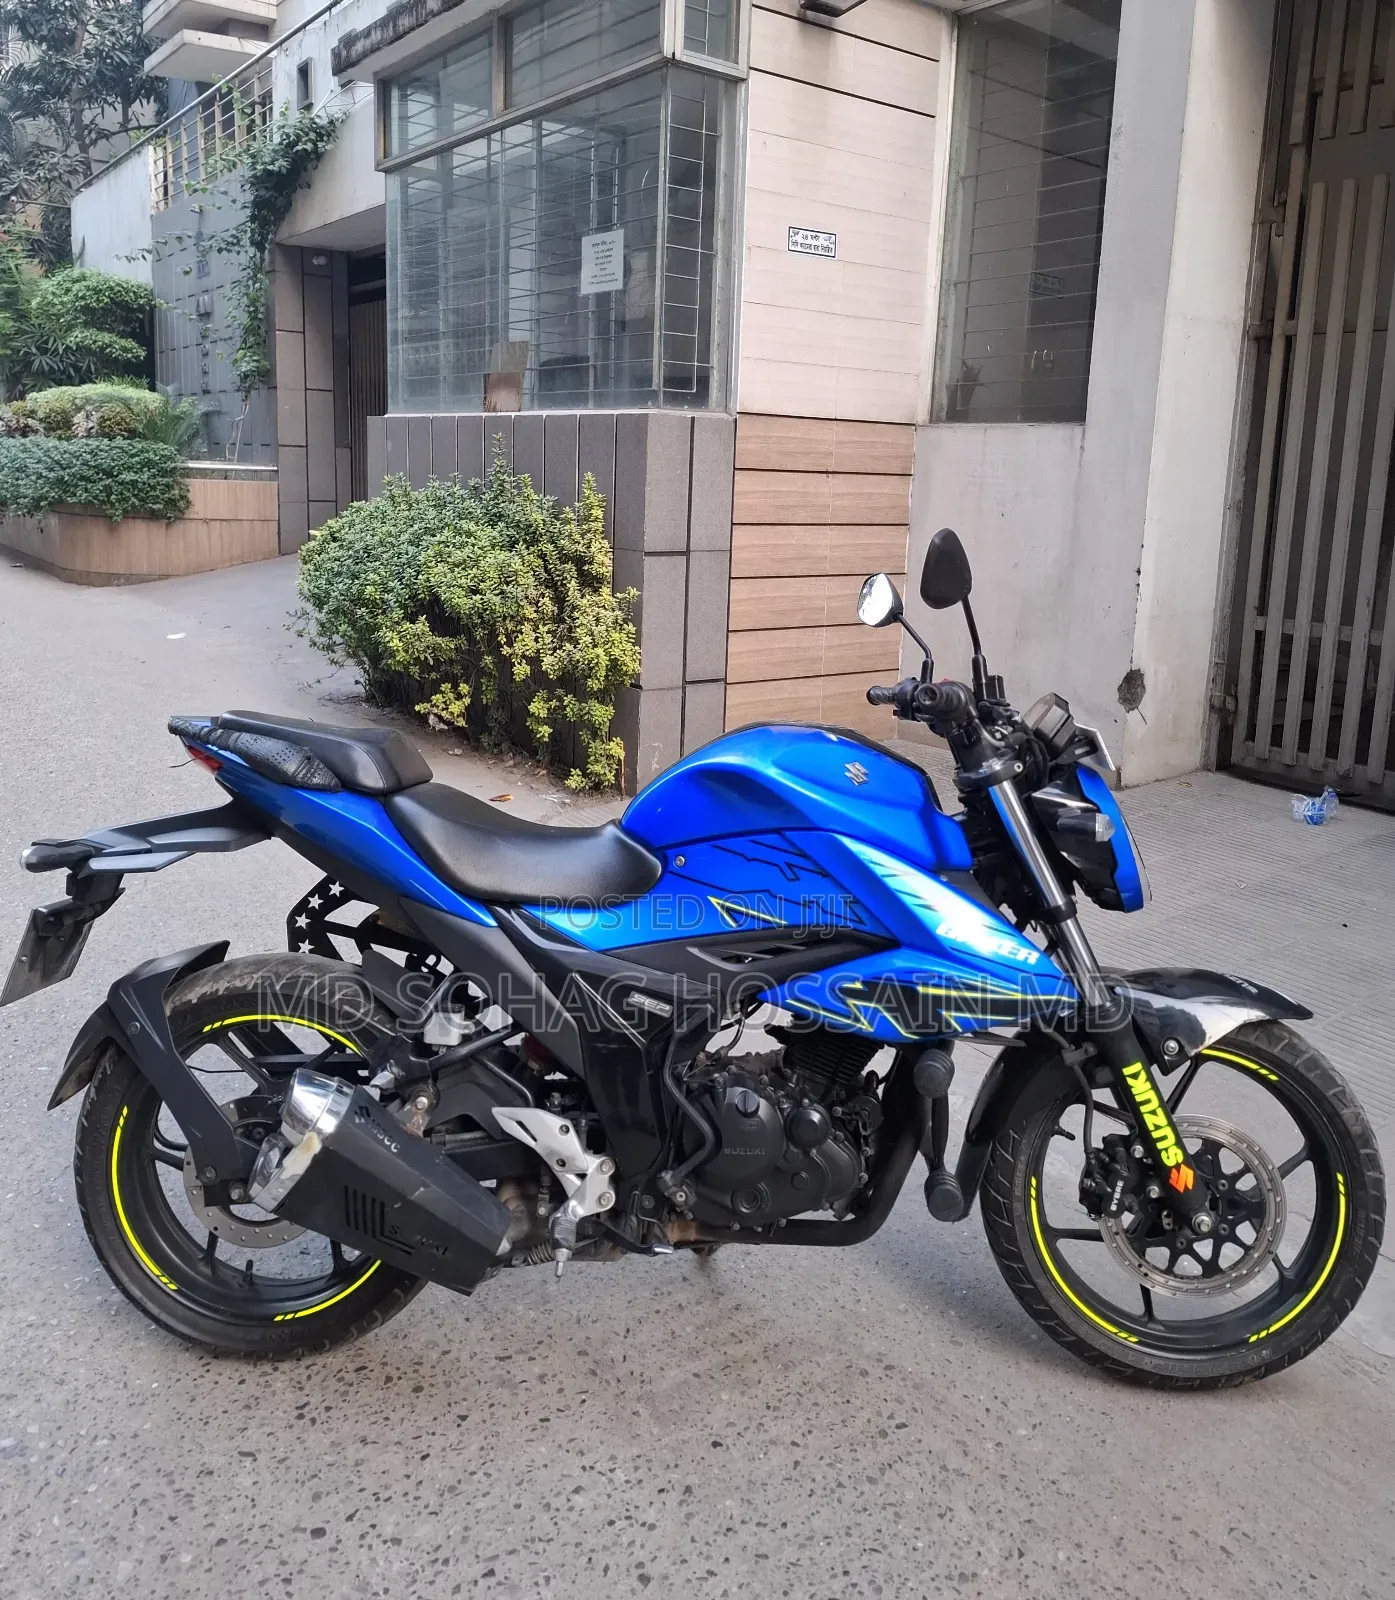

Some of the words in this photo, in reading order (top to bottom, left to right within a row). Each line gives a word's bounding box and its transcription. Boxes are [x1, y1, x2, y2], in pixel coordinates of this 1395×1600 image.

[631, 993, 670, 1010] SEP
[1121, 1060, 1185, 1168] SUZUKI
[724, 1147, 767, 1156] SUZUKI
[1110, 1179, 1125, 1212] BYBRE
